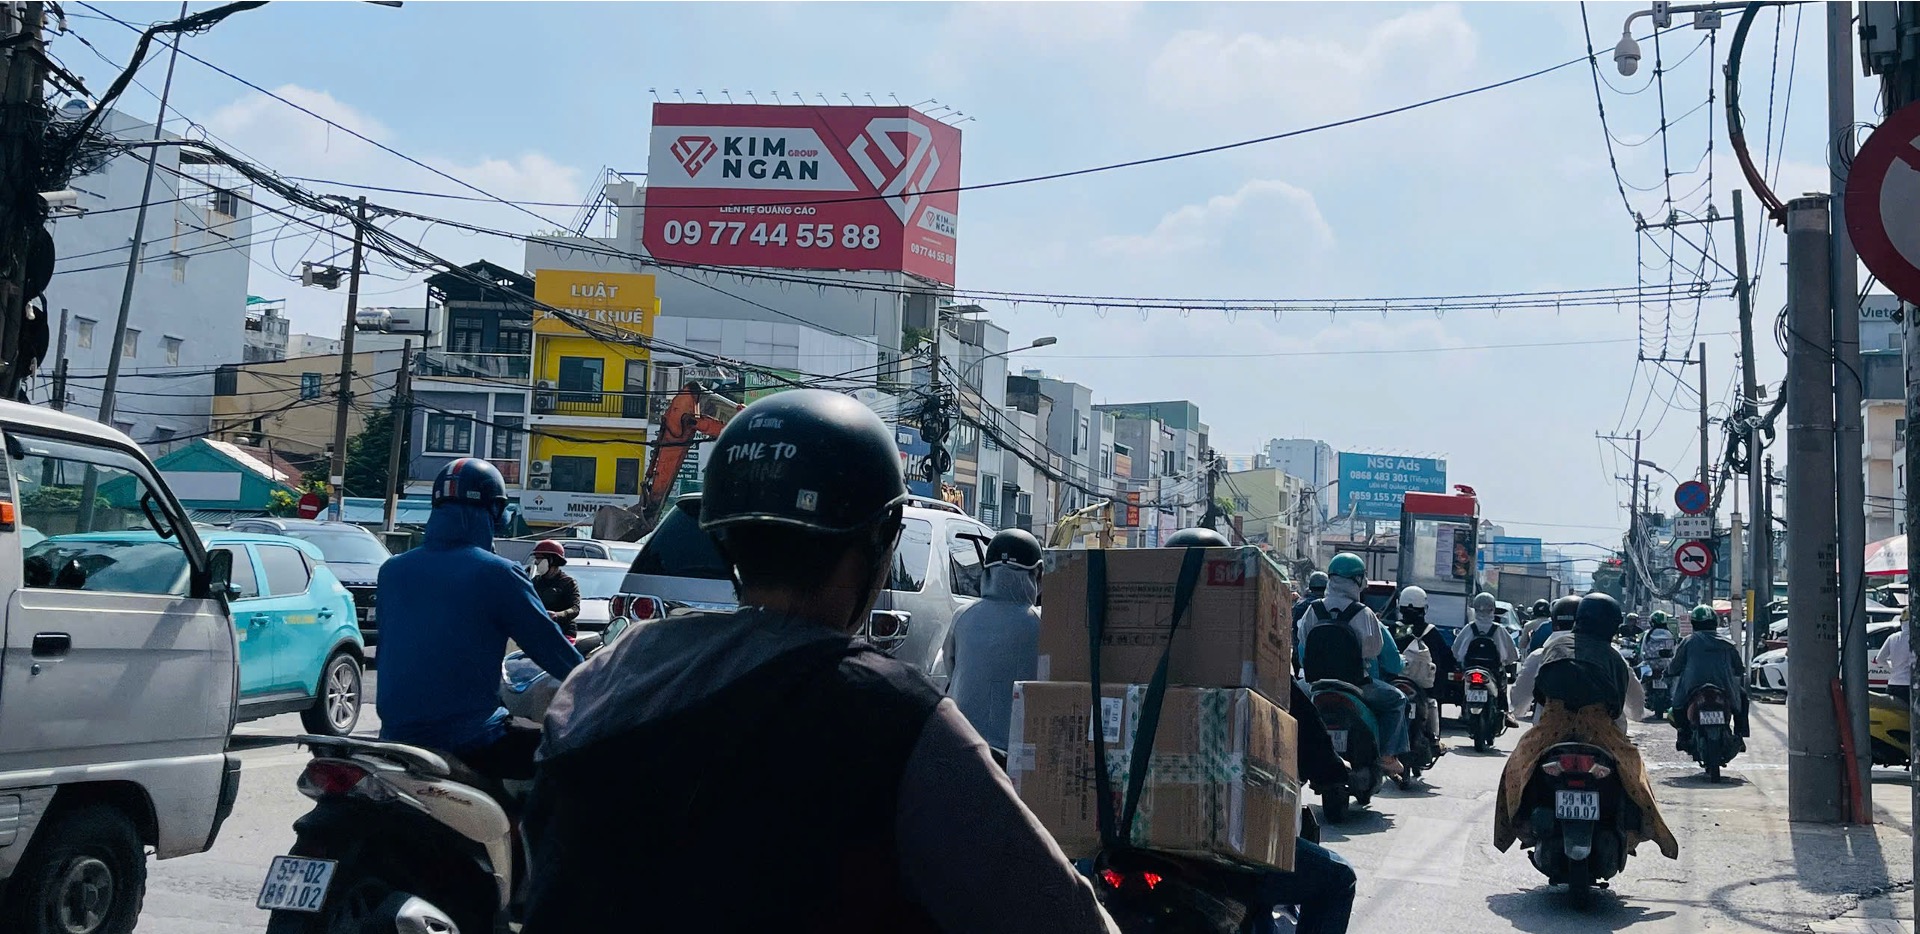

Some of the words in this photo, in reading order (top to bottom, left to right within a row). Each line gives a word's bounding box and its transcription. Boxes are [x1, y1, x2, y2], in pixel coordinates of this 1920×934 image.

[723, 136, 786, 157] KIM
[788, 149, 819, 158] GROUP
[722, 159, 819, 180] NGAN
[935, 213, 949, 224] KIM
[663, 219, 702, 245] 09
[707, 221, 746, 245] 77
[750, 222, 788, 247] 44
[795, 223, 834, 248] 55
[841, 224, 880, 250] 88
[935, 222, 955, 235] NGAN
[571, 281, 618, 302] LUẬT
[595, 307, 644, 324] KHUÊ
[727, 442, 767, 465] TIME
[769, 441, 797, 460] TO
[1367, 456, 1393, 469] NSG
[1397, 459, 1420, 472] Ads
[1374, 472, 1390, 481] 483
[1392, 474, 1408, 483] 301
[1374, 492, 1390, 502] 155
[567, 503, 596, 512] MINH
